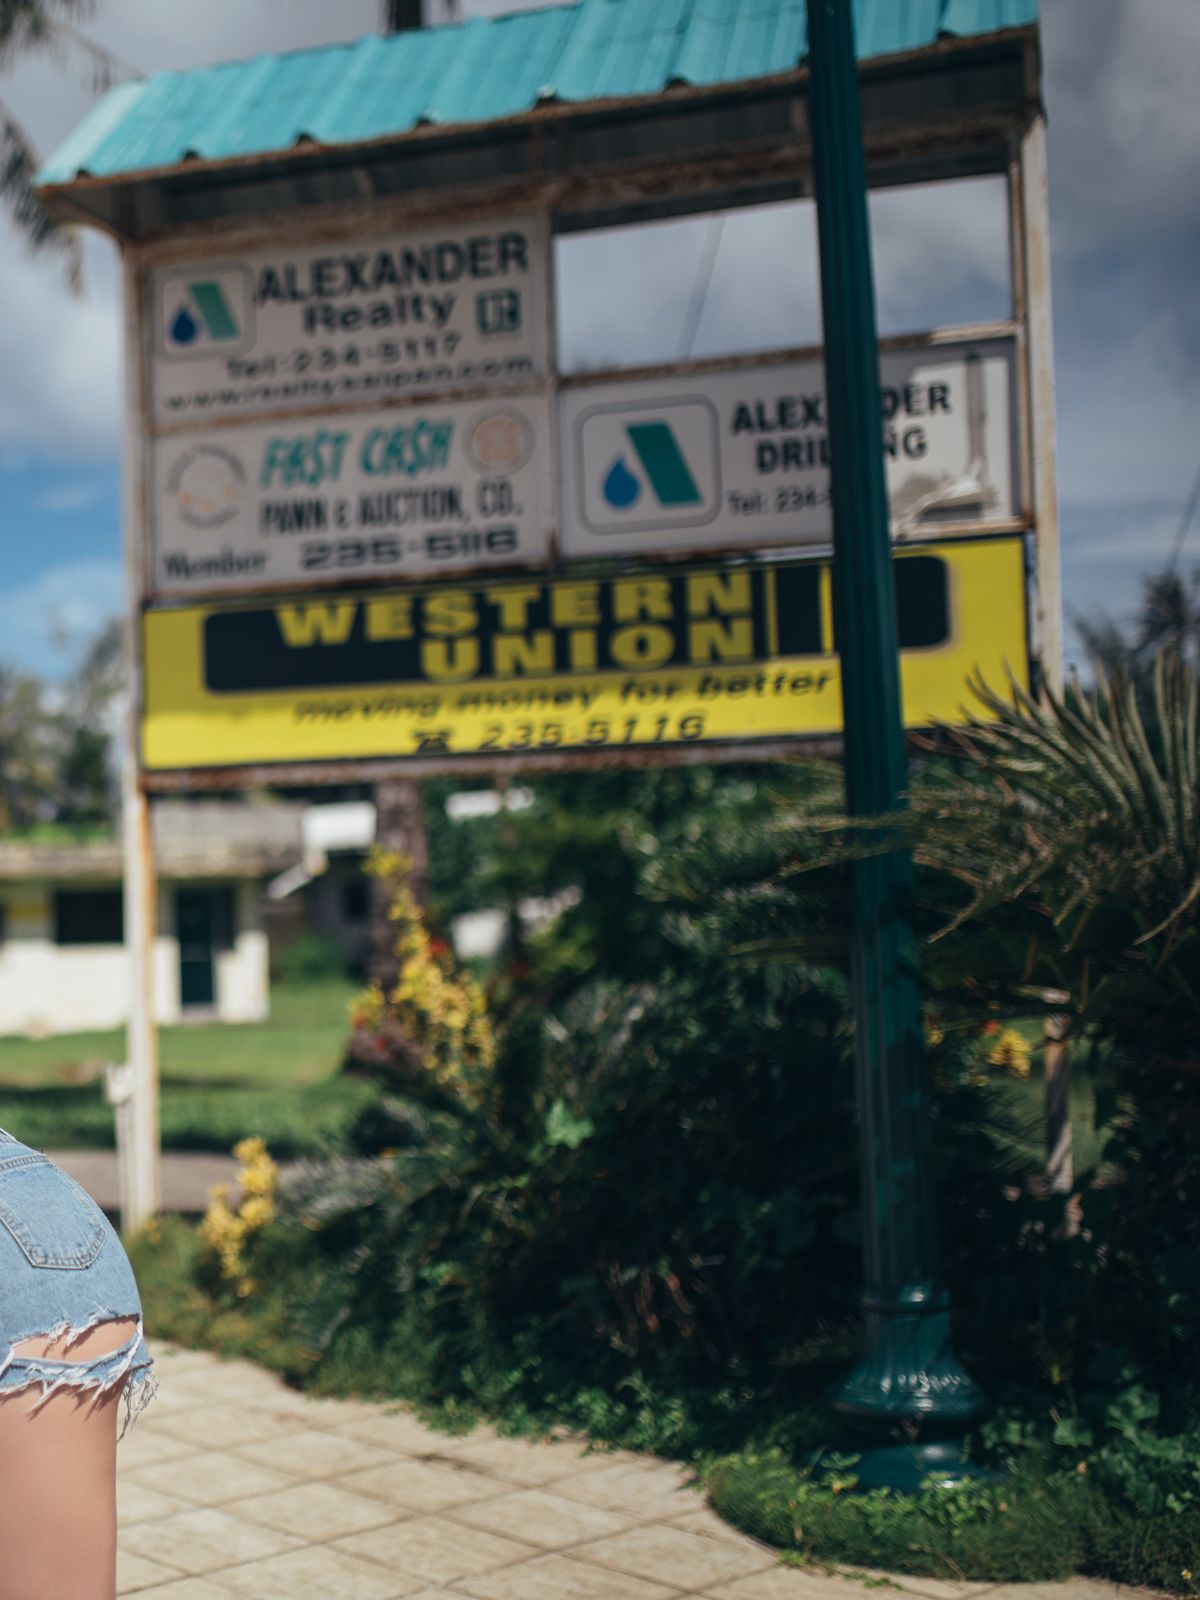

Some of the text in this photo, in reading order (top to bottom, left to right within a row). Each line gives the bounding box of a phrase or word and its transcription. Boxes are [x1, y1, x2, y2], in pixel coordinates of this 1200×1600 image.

[257, 231, 529, 306] ALEXANDER
[305, 290, 458, 336] Realty
[731, 383, 952, 436] ALEXDER
[259, 500, 328, 536] PAWN
[274, 568, 752, 648] WESTERN
[420, 616, 753, 684] UNION
[455, 680, 599, 712] money
[620, 674, 684, 706] for
[697, 668, 834, 699] better
